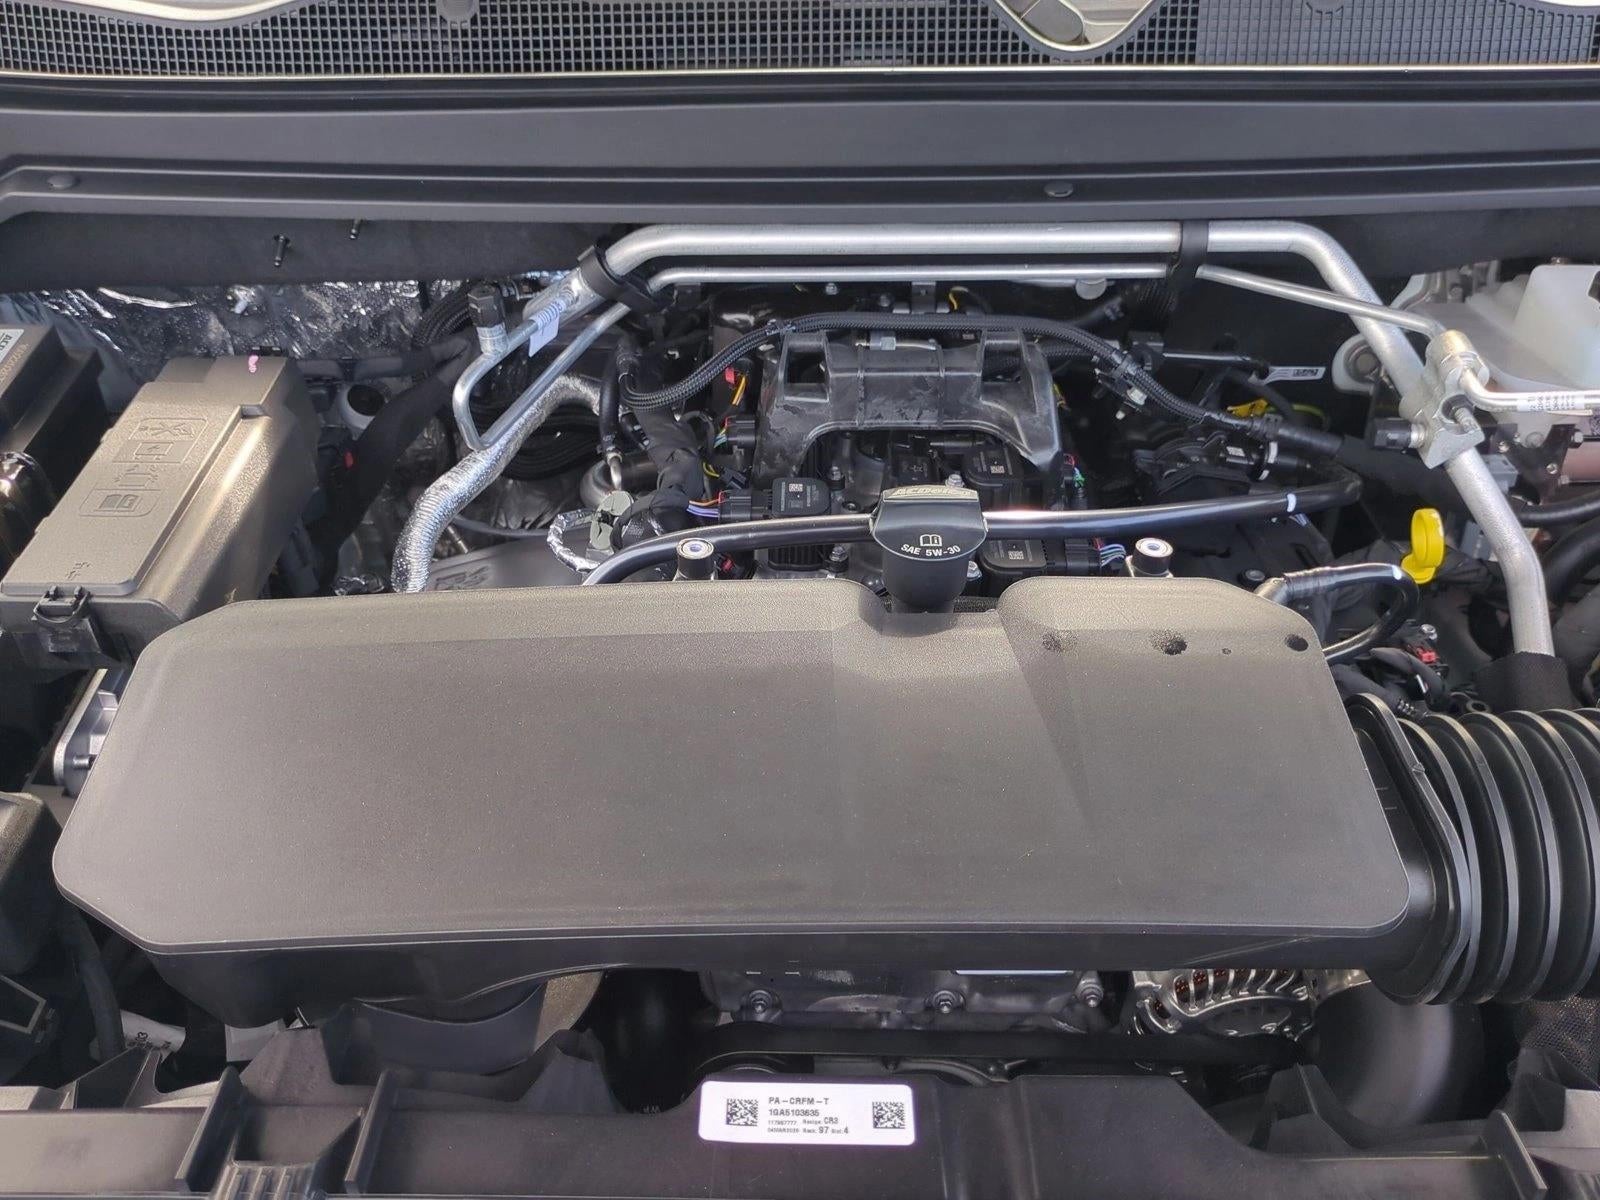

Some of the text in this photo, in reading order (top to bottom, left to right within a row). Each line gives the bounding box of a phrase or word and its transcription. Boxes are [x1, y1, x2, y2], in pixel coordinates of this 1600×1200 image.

[900, 543, 961, 557] SAE 5W-30
[824, 1116, 839, 1124] CR3
[819, 1126, 829, 1134] 97
[843, 1126, 849, 1134] 4
